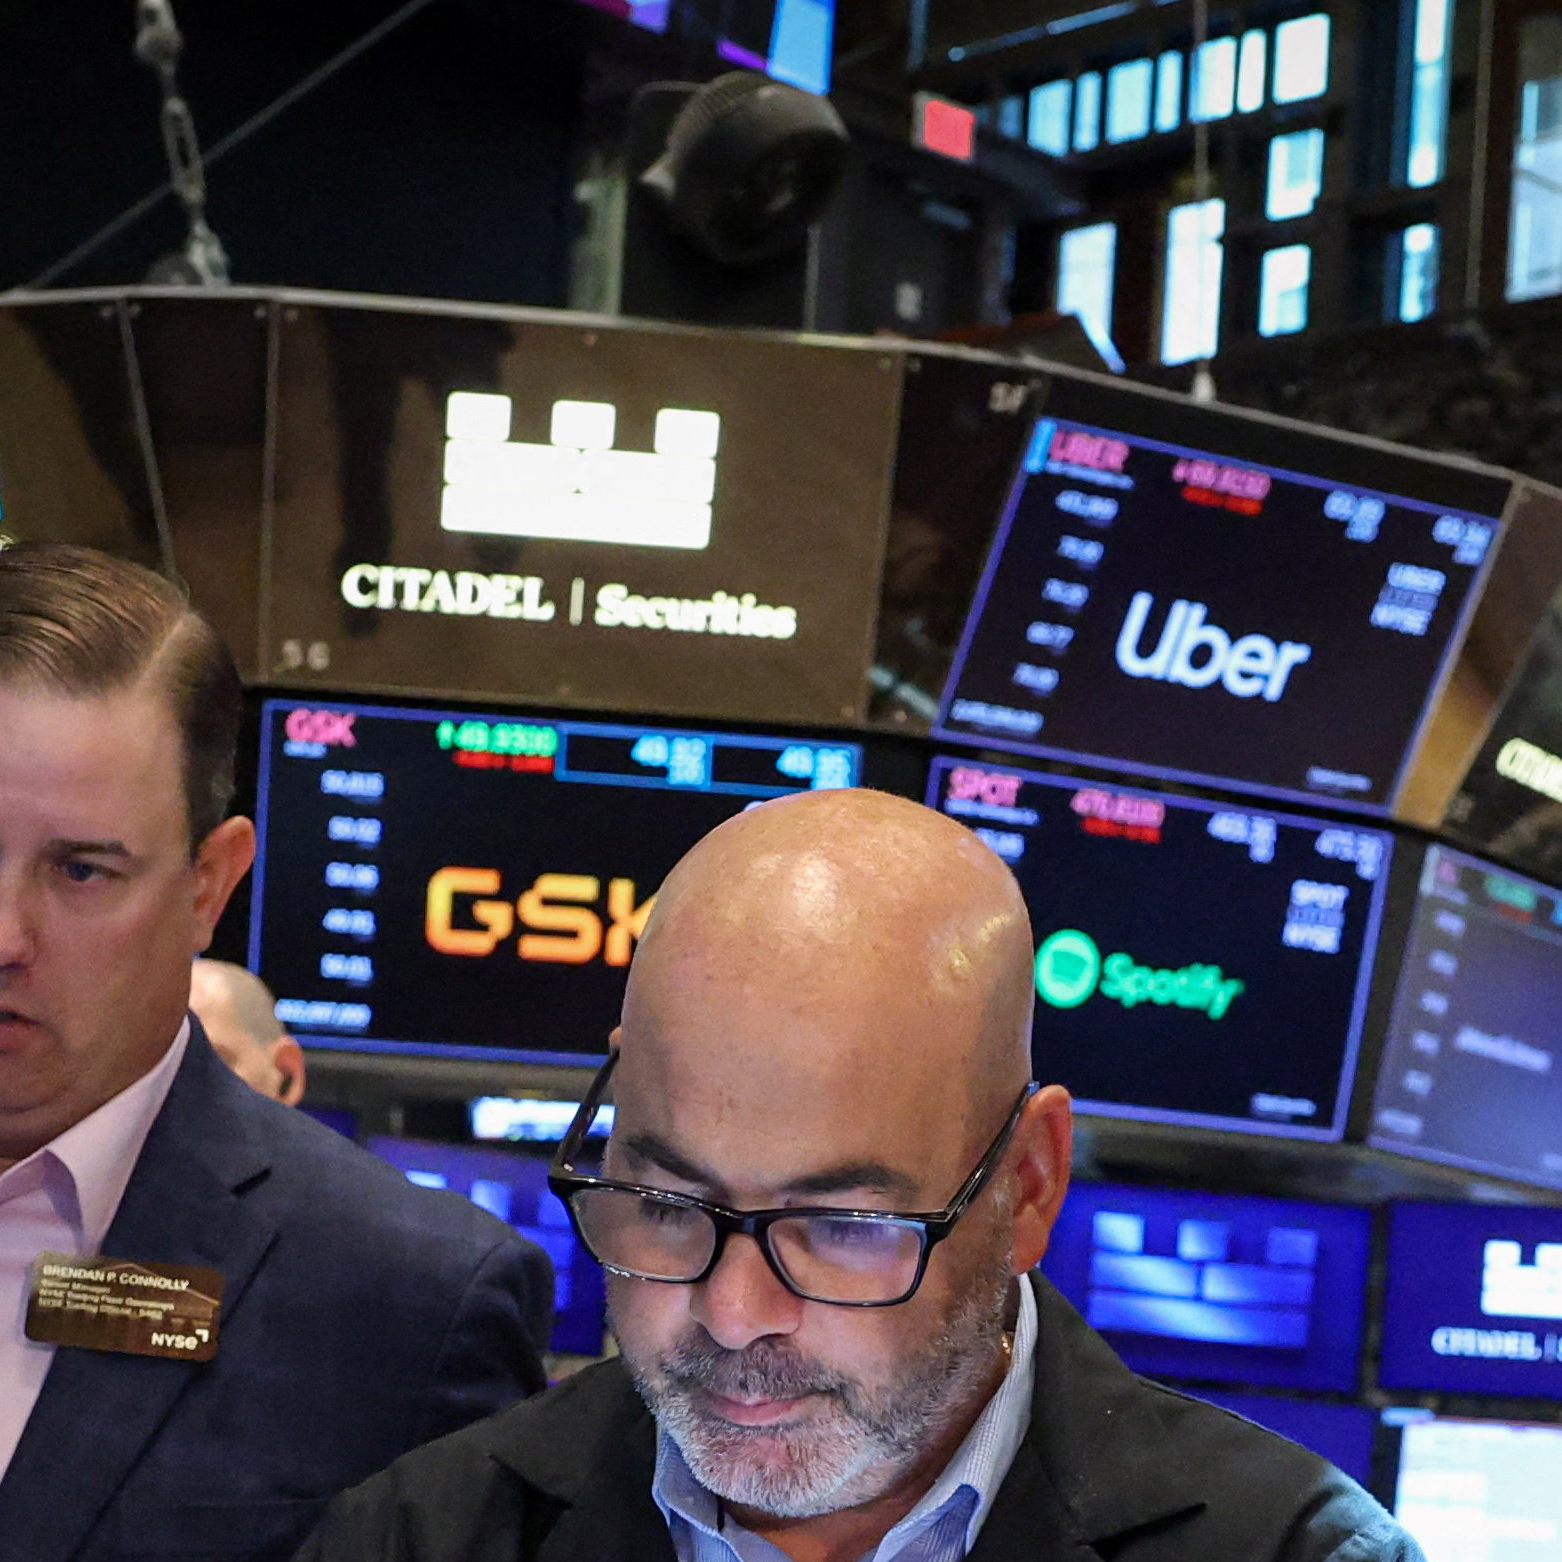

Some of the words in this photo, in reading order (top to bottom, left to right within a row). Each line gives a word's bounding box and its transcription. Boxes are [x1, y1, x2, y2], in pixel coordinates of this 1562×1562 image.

[341, 563, 555, 622] CITADEL
[594, 583, 797, 640] Securities
[1115, 591, 1311, 702] Uber
[1099, 951, 1244, 1020] Spotify
[43, 1264, 105, 1282] BRENDAN
[119, 1273, 189, 1291] CONNOLLY
